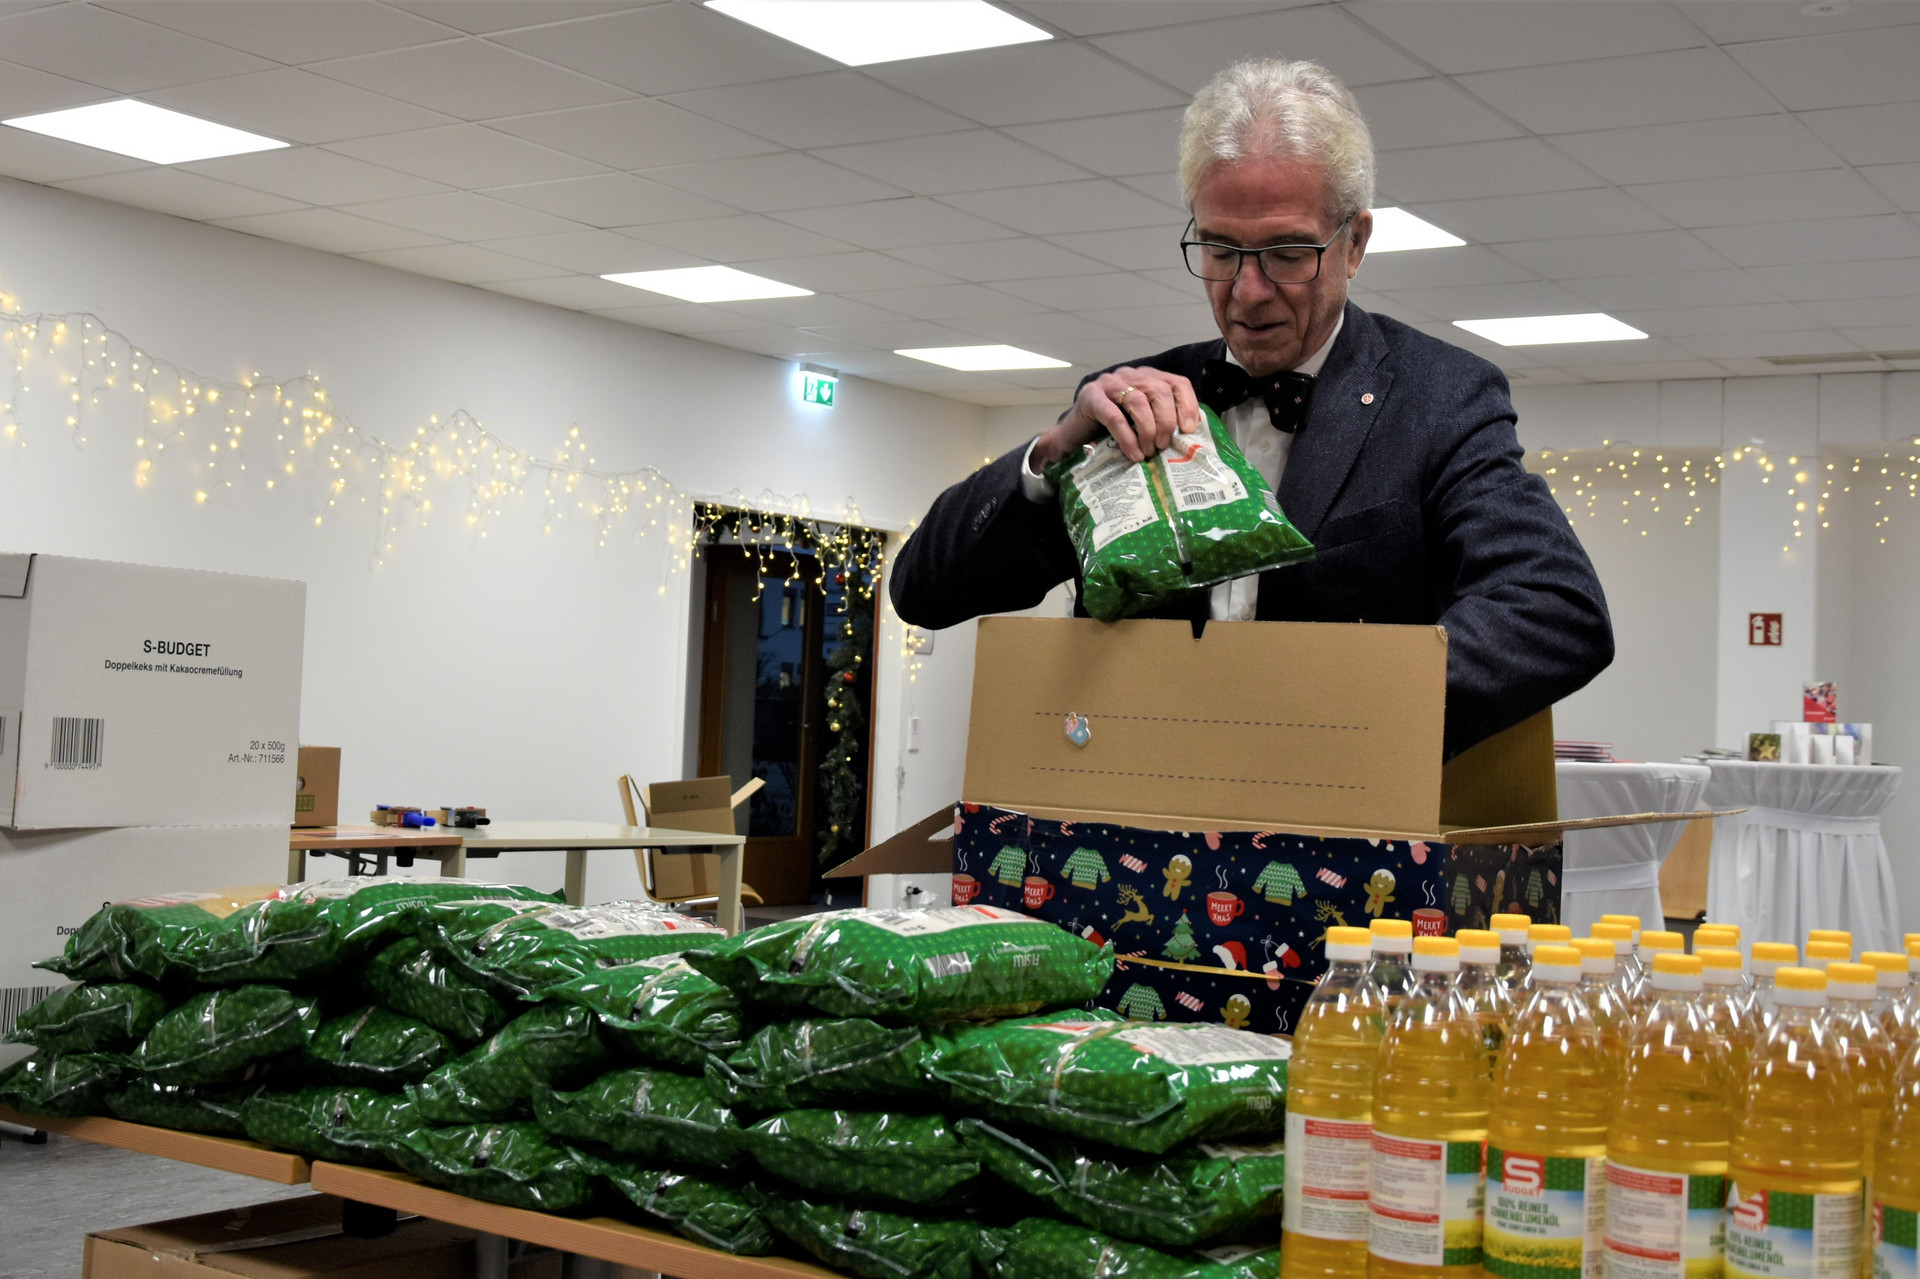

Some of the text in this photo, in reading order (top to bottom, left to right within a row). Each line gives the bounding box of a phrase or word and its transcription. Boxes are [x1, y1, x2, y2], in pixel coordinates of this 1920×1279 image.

[143, 640, 211, 657] S-BUDGET
[104, 659, 243, 678] Doppelkeks mit Kakaocremefüllung
[250, 740, 260, 750] 20
[267, 741, 285, 752] 500g
[228, 753, 285, 764] Art.-Nr.: 711566
[954, 883, 971, 893] MERRY
[1024, 886, 1045, 896] MERRY
[954, 893, 969, 902] XMAS
[1025, 896, 1042, 905] XMAS
[1211, 902, 1232, 912] MERRY
[1212, 913, 1231, 922] XMAS
[1416, 919, 1441, 930] MERRY
[1505, 1156, 1540, 1190] S
[1503, 1184, 1542, 1197] BUDGET
[1518, 1200, 1549, 1214] REINES
